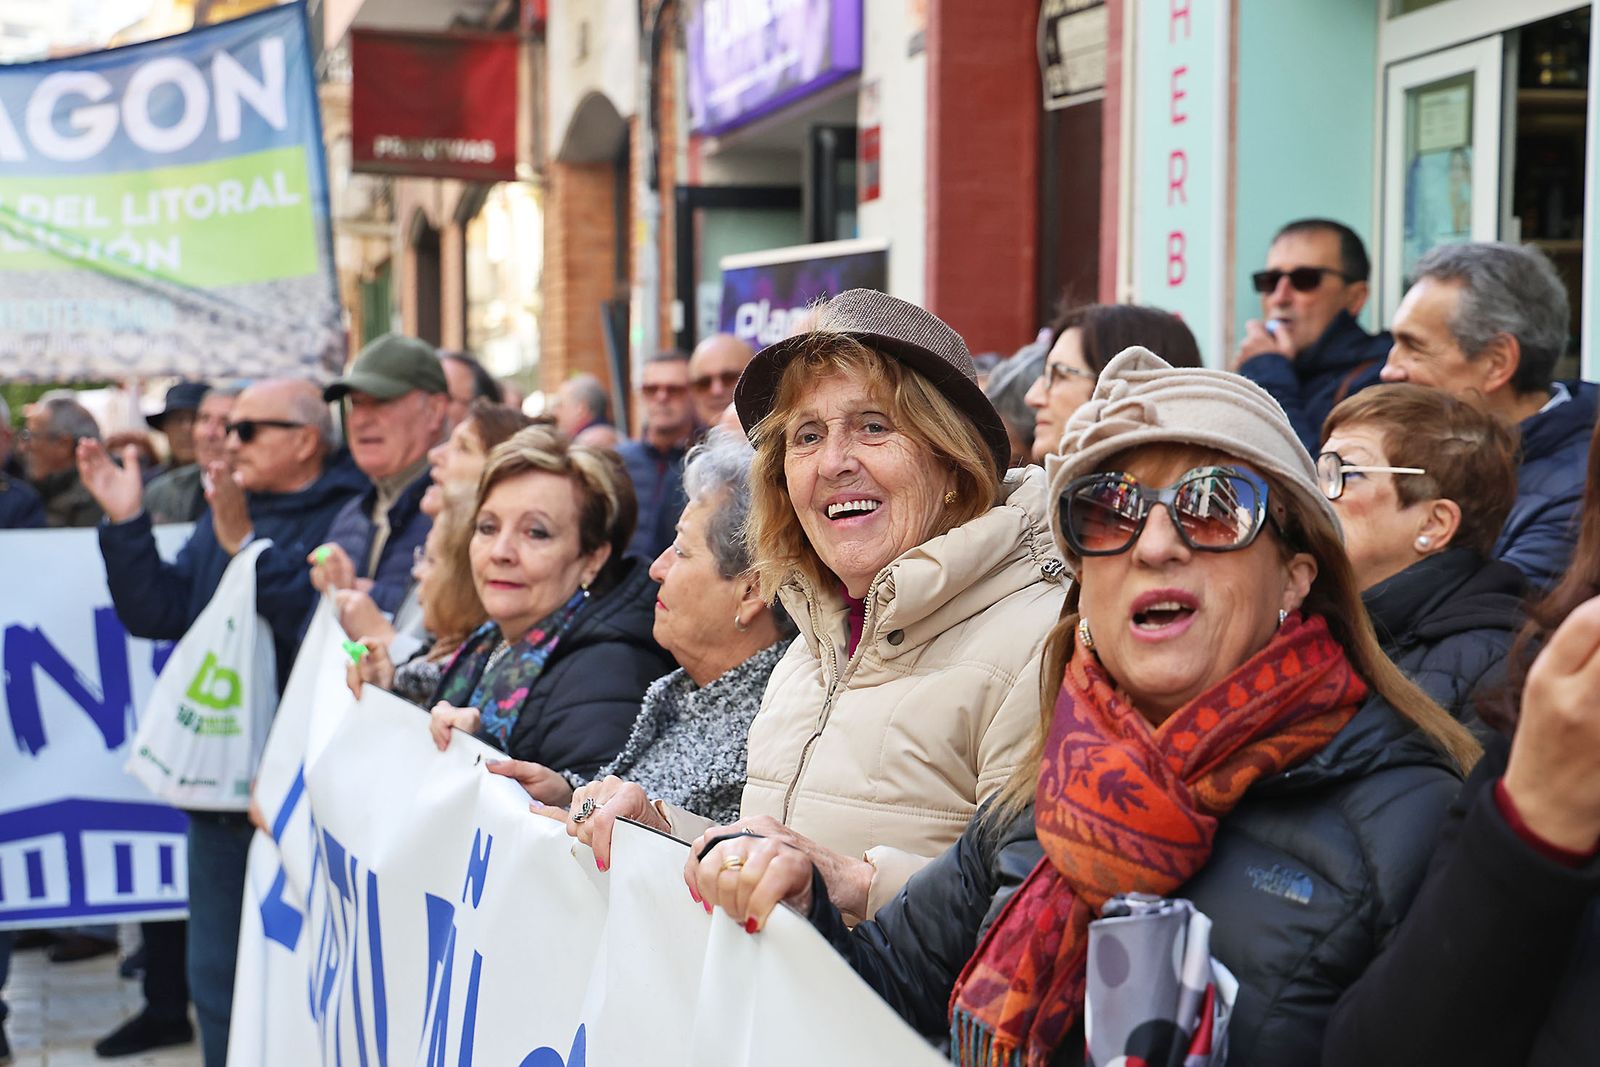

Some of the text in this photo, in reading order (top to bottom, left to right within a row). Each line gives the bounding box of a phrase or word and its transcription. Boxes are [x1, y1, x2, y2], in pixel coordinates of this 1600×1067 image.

[18, 171, 302, 229] DEL LITORAL
[1166, 0, 1191, 322] HERB
